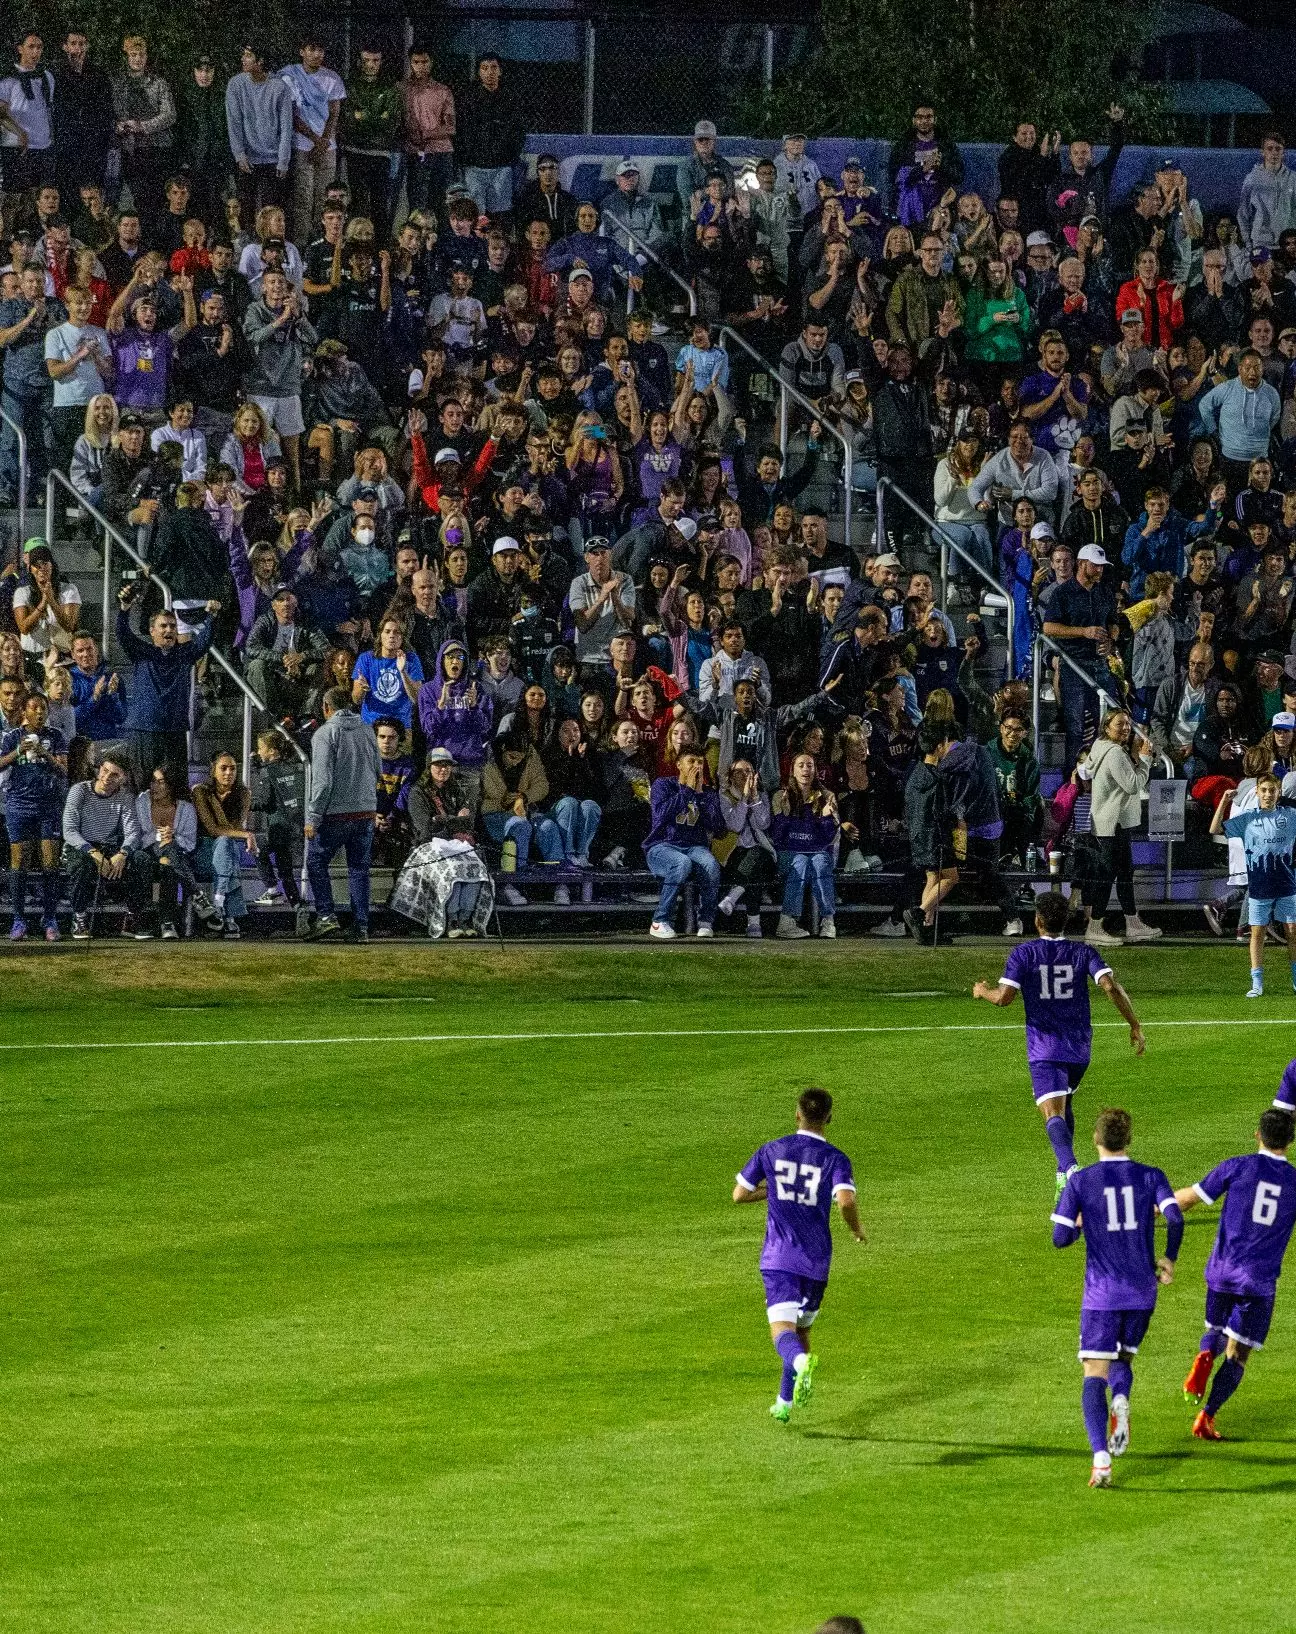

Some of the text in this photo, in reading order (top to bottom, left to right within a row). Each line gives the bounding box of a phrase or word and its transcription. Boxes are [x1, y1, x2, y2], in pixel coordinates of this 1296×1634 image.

[1038, 964, 1074, 999] 12
[774, 1158, 822, 1206] 23
[1252, 1180, 1282, 1226] 6
[1103, 1185, 1138, 1232] 11
